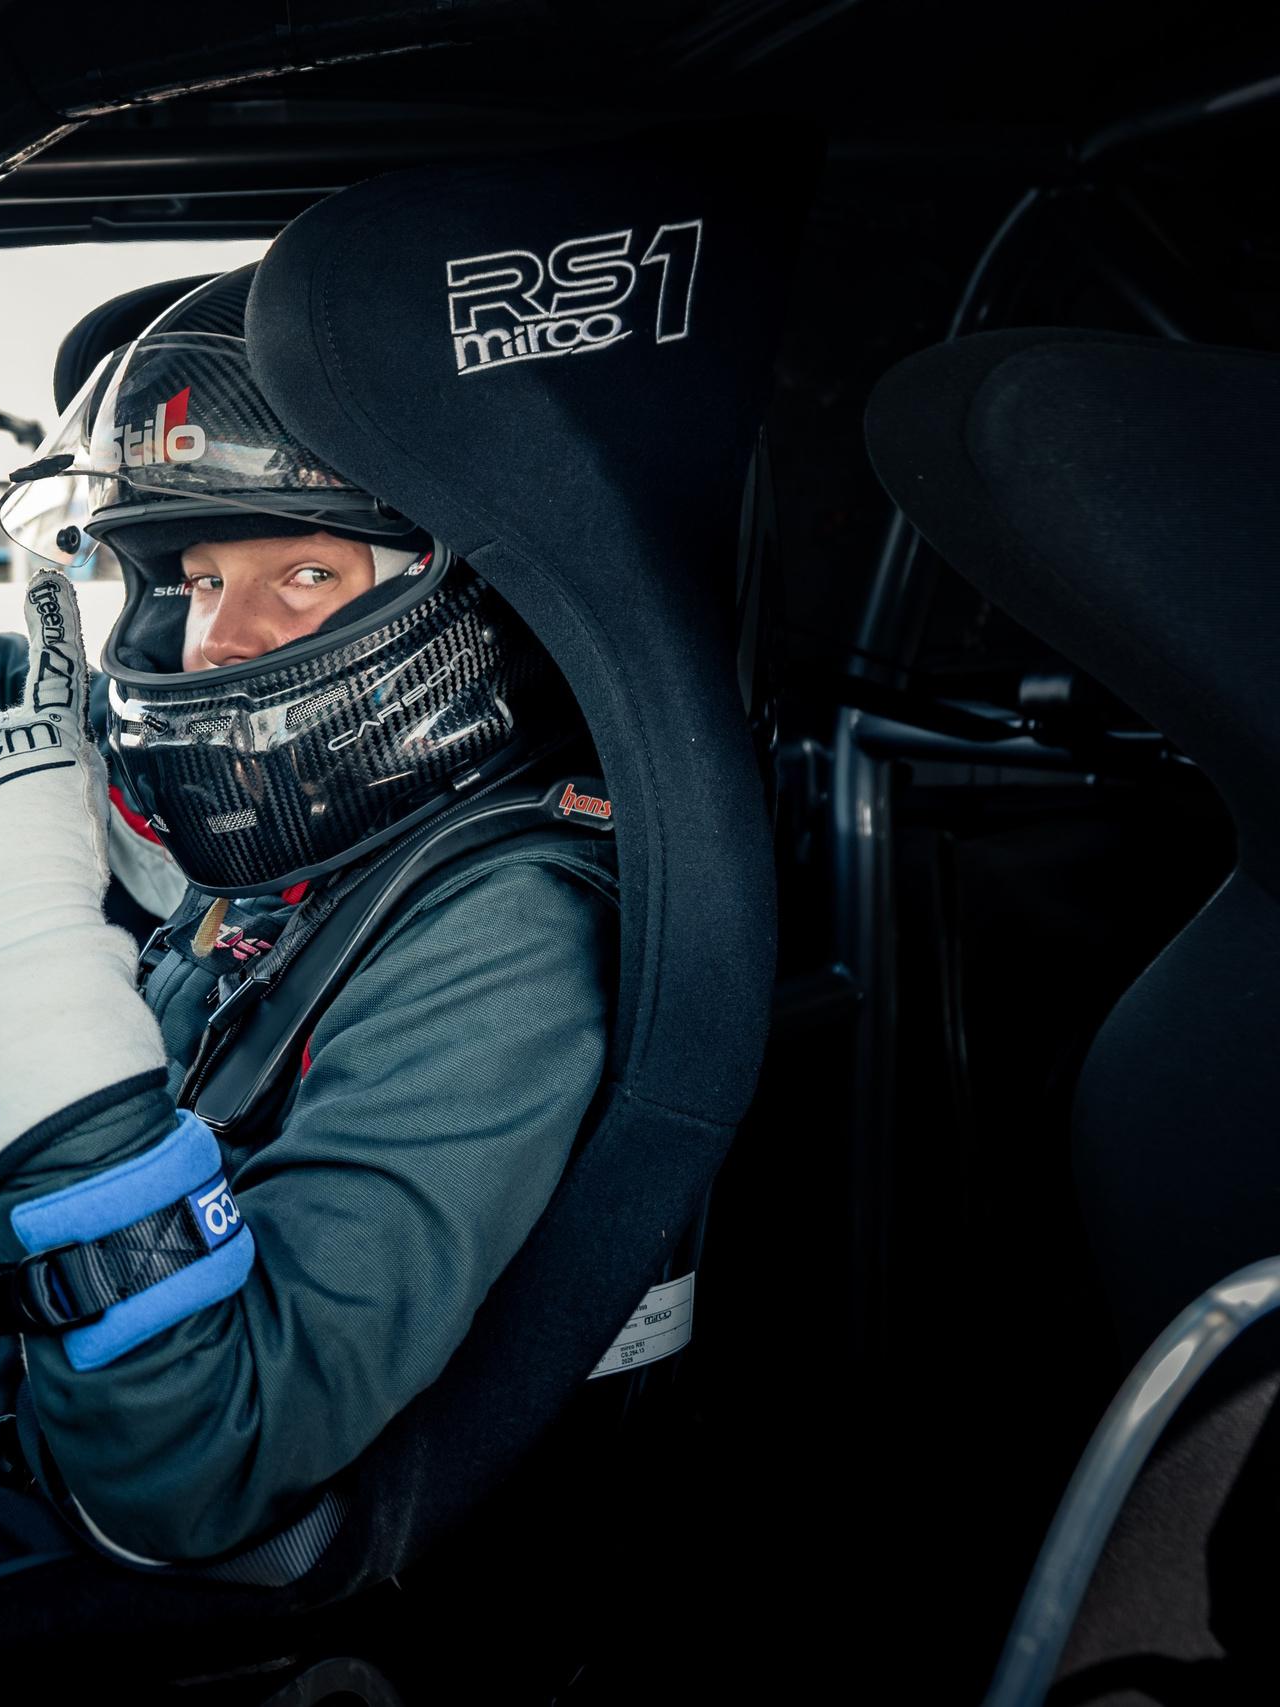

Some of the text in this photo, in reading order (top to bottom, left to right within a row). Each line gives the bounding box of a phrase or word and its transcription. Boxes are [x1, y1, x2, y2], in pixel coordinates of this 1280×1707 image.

[446, 217, 703, 345] RS1
[454, 312, 622, 371] mirco
[559, 783, 612, 817] hans
